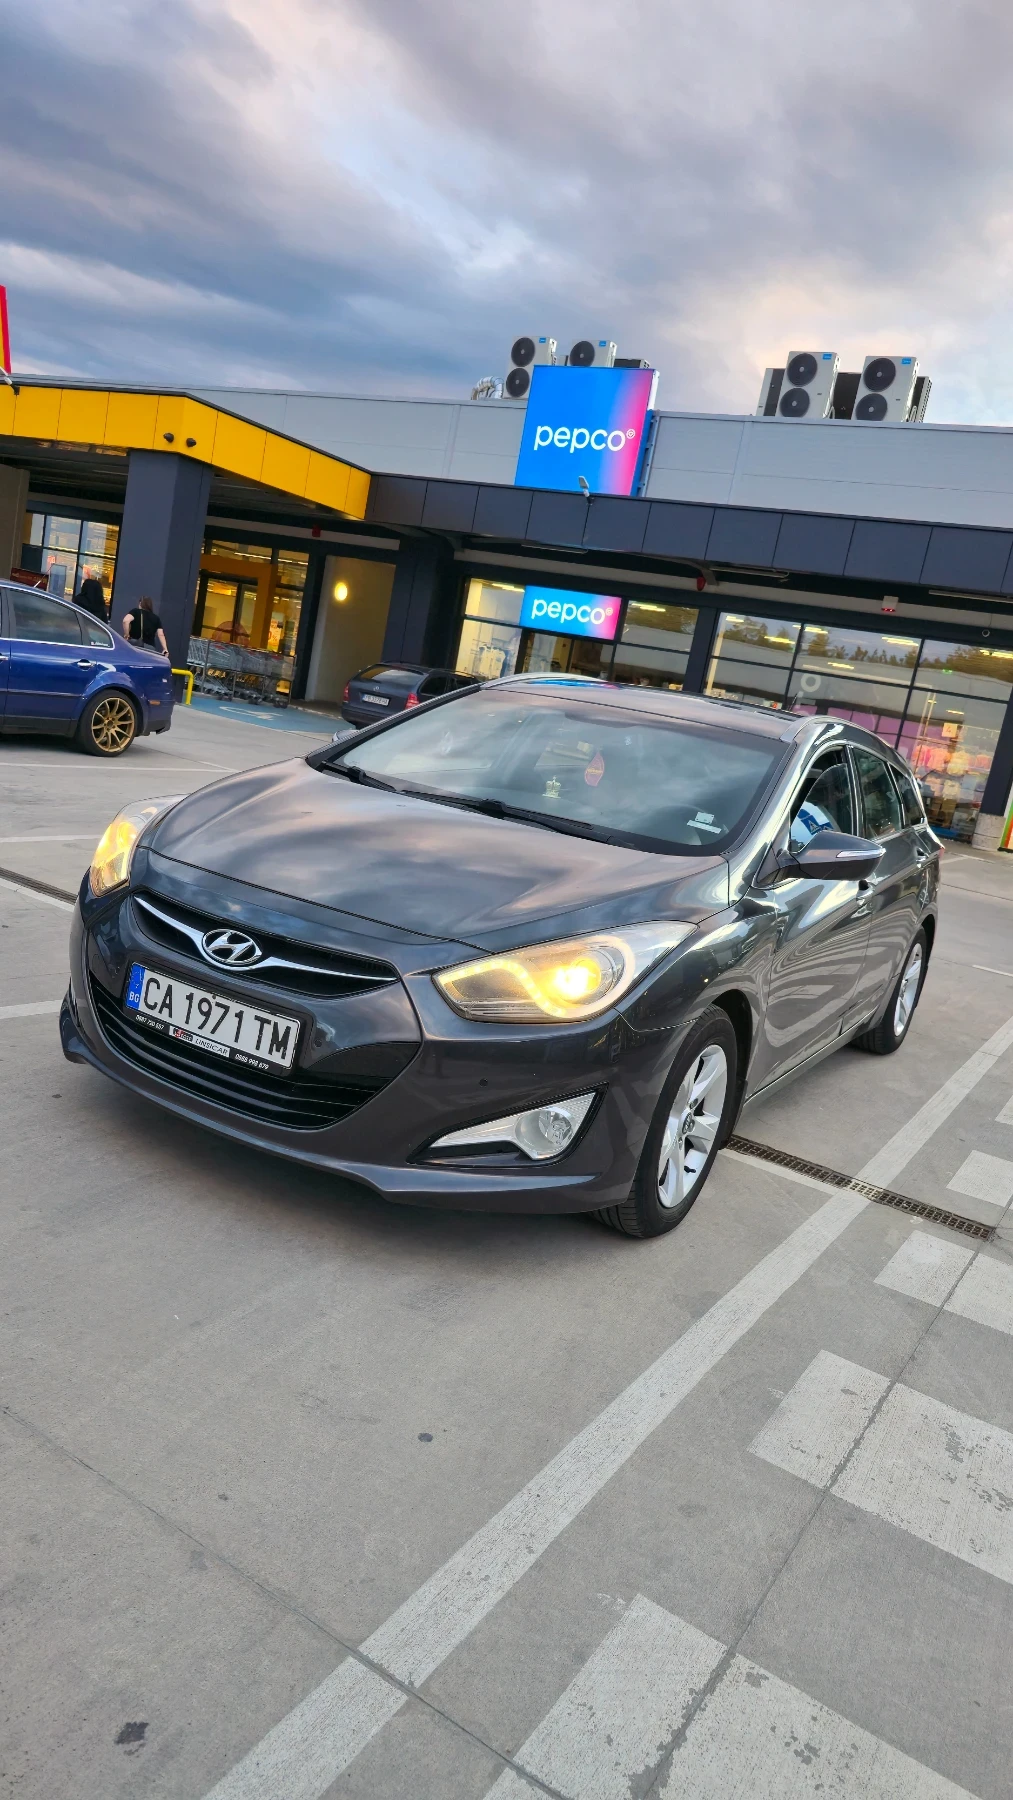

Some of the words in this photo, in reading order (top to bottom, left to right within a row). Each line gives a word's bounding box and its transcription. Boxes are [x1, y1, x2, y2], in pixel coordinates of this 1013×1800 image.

[534, 425, 626, 453] pepco
[531, 599, 606, 625] pepco
[129, 991, 140, 1003] BG
[143, 977, 173, 1018] CA
[185, 992, 244, 1043] 1971
[254, 1014, 292, 1060] TM
